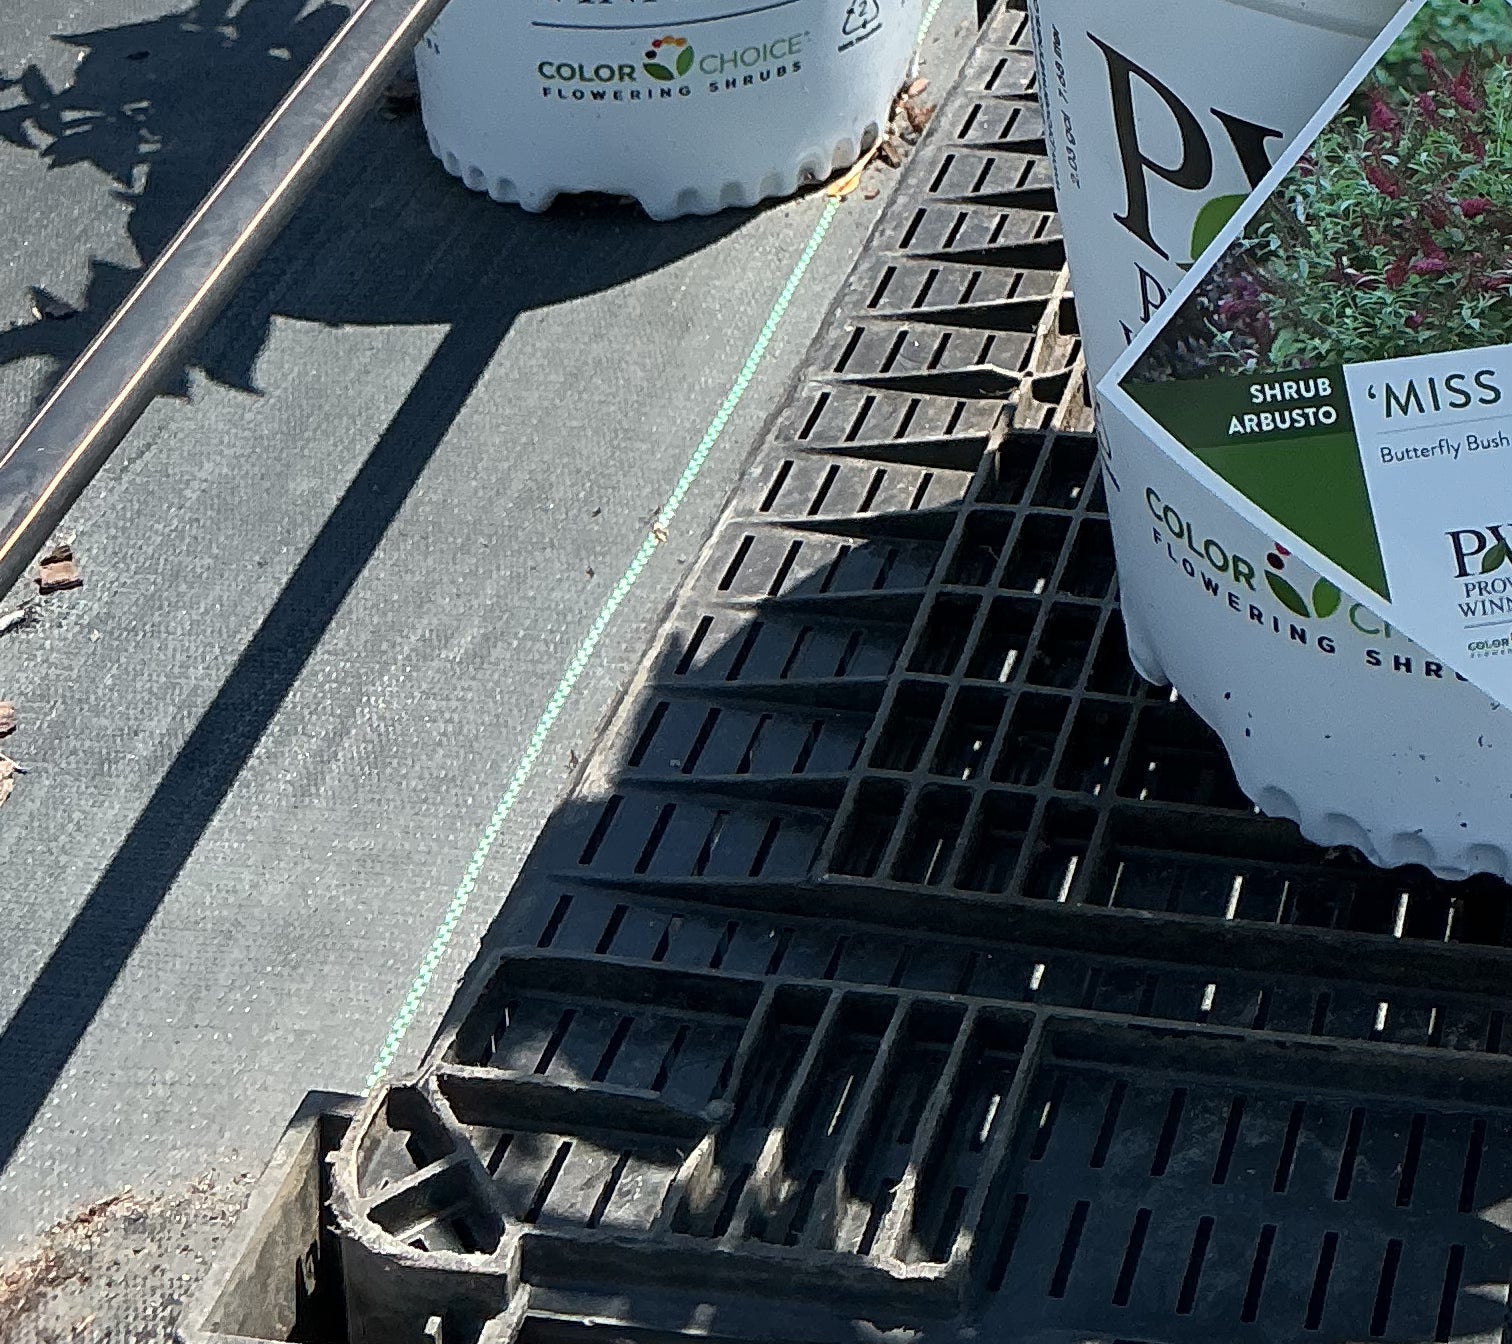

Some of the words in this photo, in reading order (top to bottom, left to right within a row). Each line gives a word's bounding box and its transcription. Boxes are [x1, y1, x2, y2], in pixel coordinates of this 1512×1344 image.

[537, 59, 637, 84] COLOR
[698, 31, 805, 76] CHOICE
[541, 85, 692, 102] FLOWERING
[708, 61, 803, 94] SHRUBS
[1053, 60, 1069, 105] 7.68
[1060, 109, 1077, 146] gal
[1066, 145, 1081, 190] 2.03
[1249, 376, 1333, 405] SHRUB
[1227, 405, 1338, 438] ARBUSTO
[1379, 436, 1461, 465] Butterfly
[1466, 429, 1512, 454] Bush
[1144, 486, 1258, 593] COLOR
[1151, 525, 1337, 656] FLOWERING
[1467, 637, 1510, 652] COLOR
